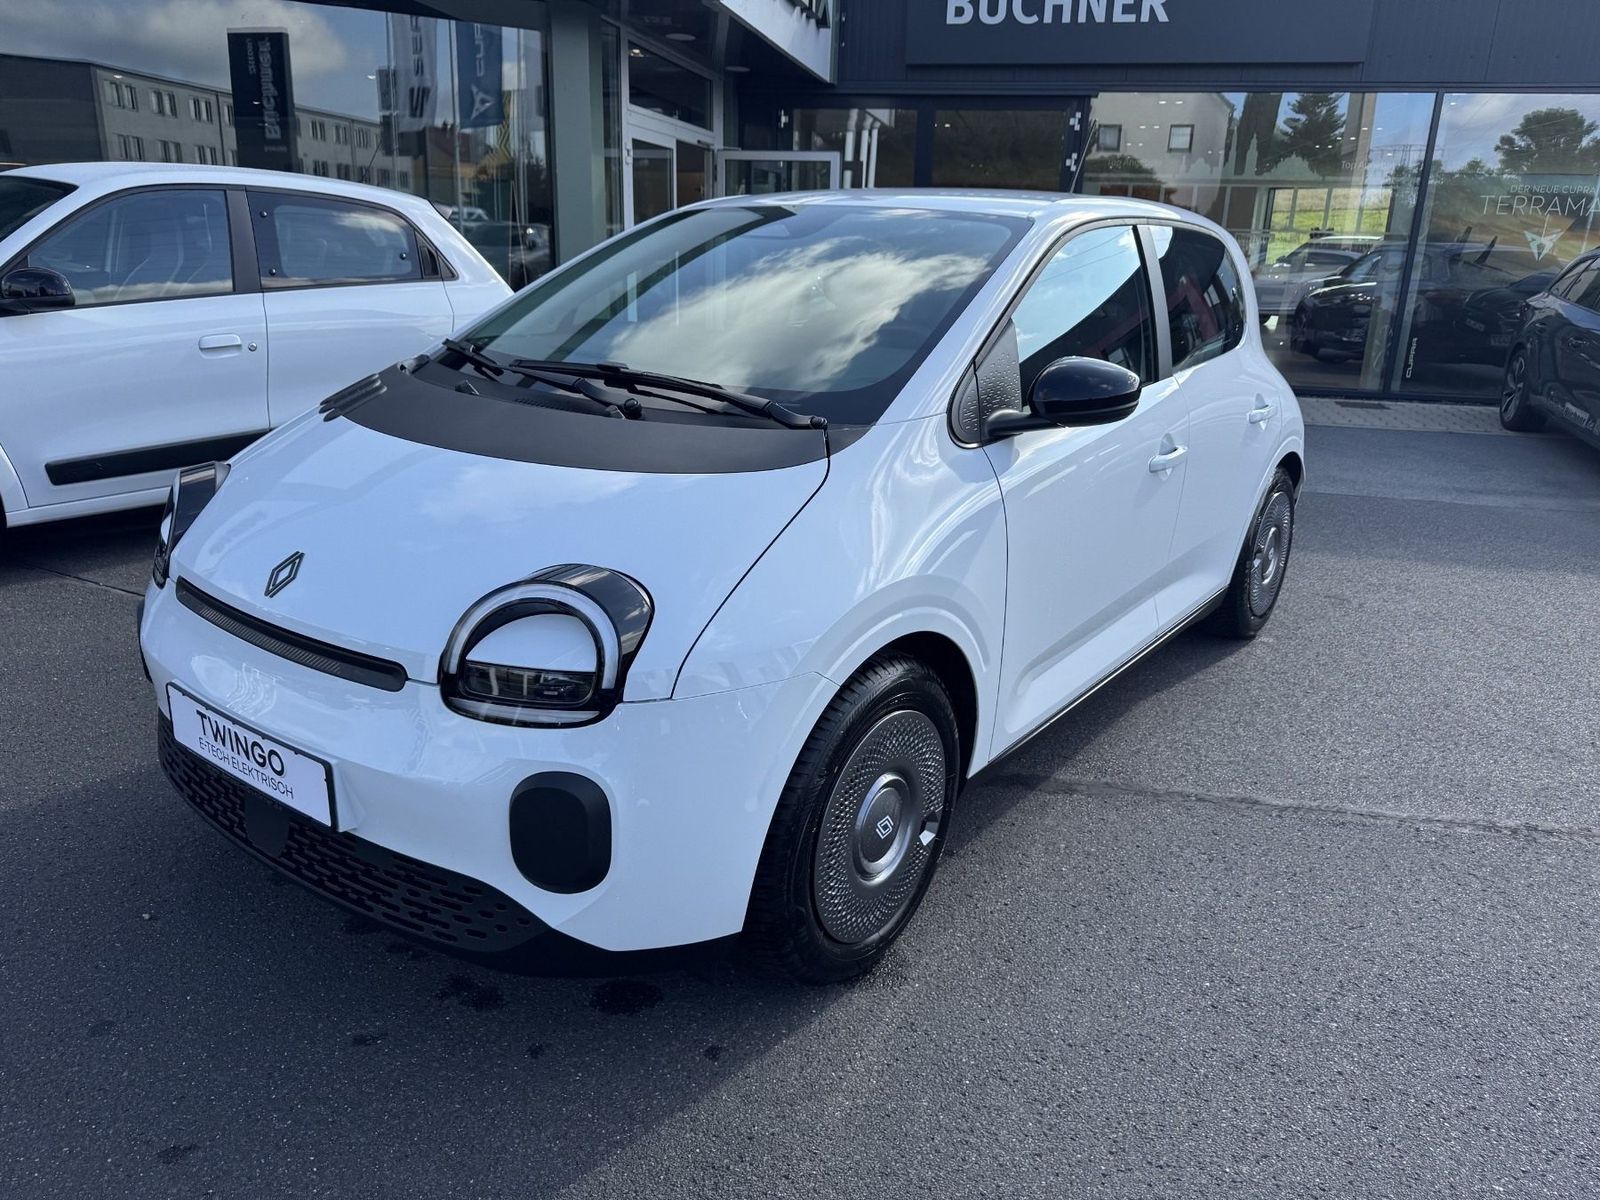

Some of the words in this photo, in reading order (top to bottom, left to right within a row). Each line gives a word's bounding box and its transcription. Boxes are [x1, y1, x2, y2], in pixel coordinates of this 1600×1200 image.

[1510, 184, 1531, 194] DER
[1532, 184, 1560, 194] NEUE
[1562, 185, 1597, 195] CUPRA
[196, 709, 285, 777] TWINGO
[231, 756, 294, 799] ELEKTRISCH
